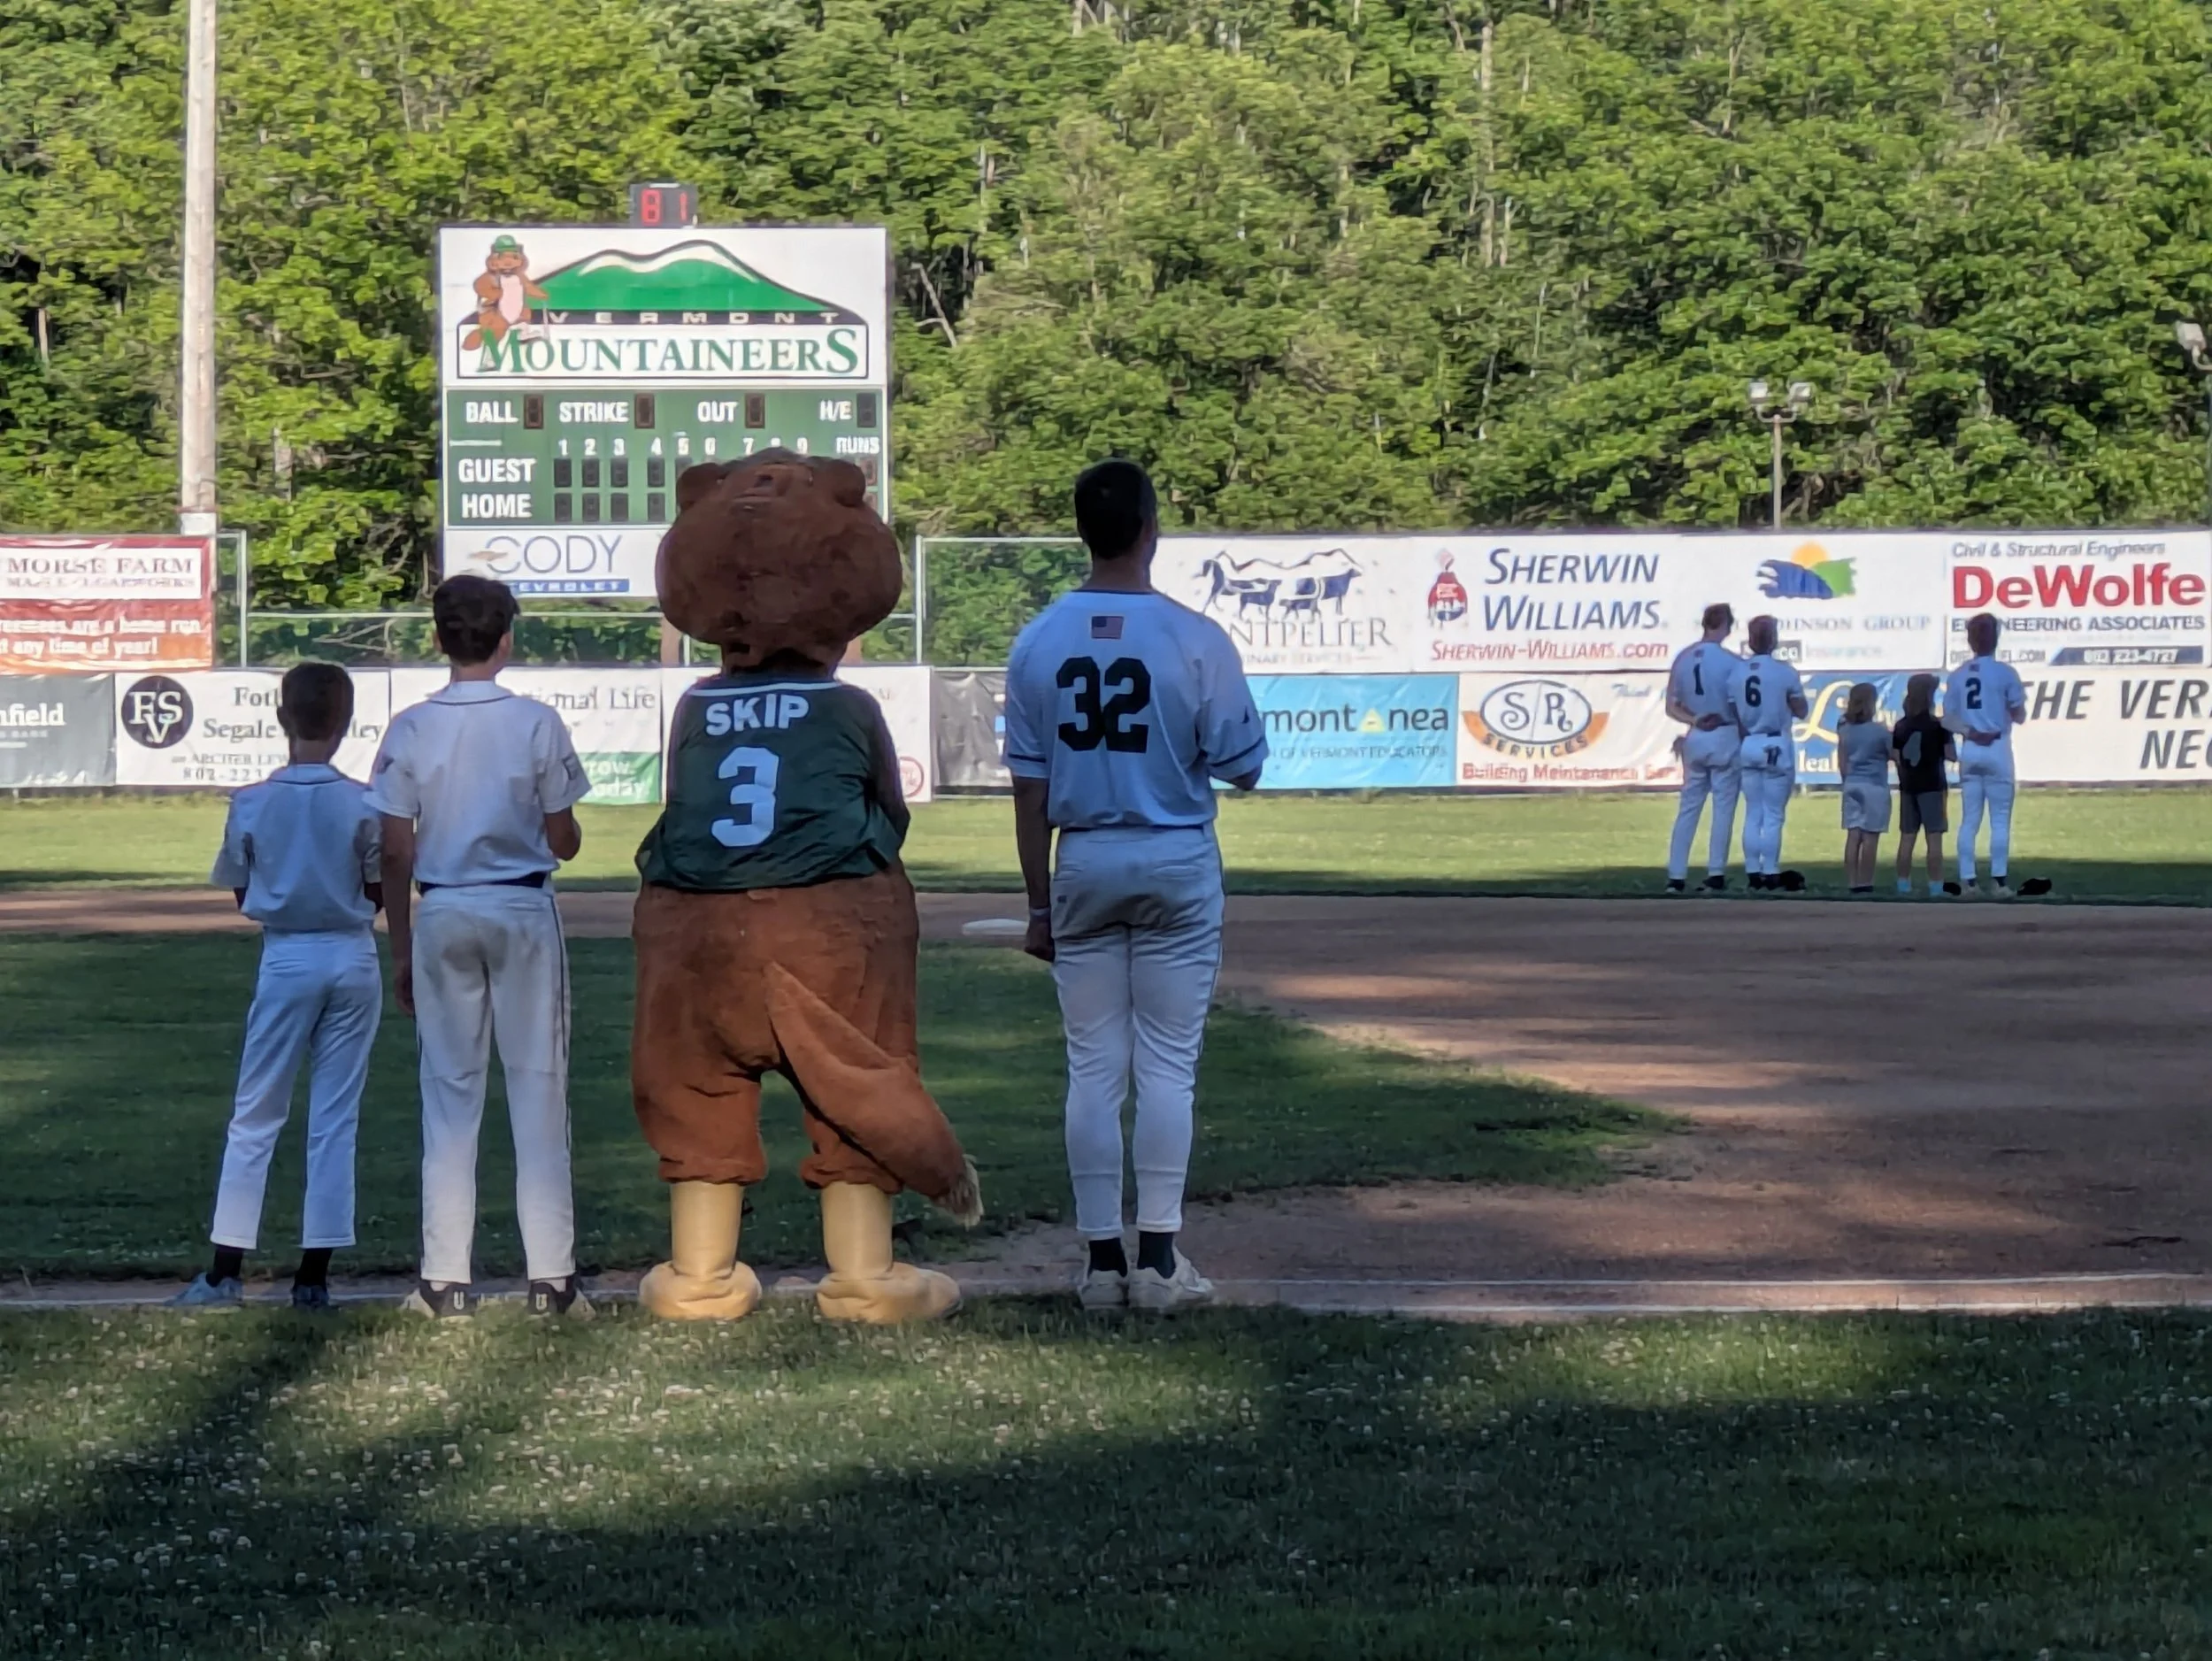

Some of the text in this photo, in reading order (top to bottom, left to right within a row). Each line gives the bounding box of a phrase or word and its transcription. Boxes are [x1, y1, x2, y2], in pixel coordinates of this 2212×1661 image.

[550, 312, 839, 325] VERMONT
[478, 328, 858, 374] MOUNTAINEERS
[465, 401, 518, 423] BALL
[559, 402, 629, 423] STRIKE
[697, 401, 738, 422] OUT
[819, 400, 852, 421] H/E
[558, 439, 568, 456] 1
[585, 439, 596, 456] 2
[650, 437, 662, 456] 4
[836, 436, 879, 455] RUNS
[458, 458, 536, 482] GUEST
[461, 493, 533, 519] HOME
[486, 534, 623, 574] CODY
[1991, 543, 2001, 556] &
[2007, 542, 2083, 558] Structural
[2085, 542, 2165, 561] Engineers
[7, 558, 192, 573] MORSE FARM
[511, 580, 621, 593] EVROLET
[1953, 563, 2206, 609] DeWolfe
[1227, 619, 1395, 648] NTPELIER
[1952, 615, 2205, 632] ENEERING ASSOCIATES
[1694, 663, 1704, 696] 1
[1745, 675, 1763, 707] 6
[610, 685, 656, 709] Life
[1056, 657, 1150, 753] 32
[1965, 677, 1982, 710] 2
[2121, 680, 2212, 719] VER
[705, 693, 809, 736] SKIP
[1263, 704, 1356, 732] mont
[203, 719, 277, 743] Segale
[1483, 733, 1590, 760] SERVICES
[2139, 729, 2212, 770] NE
[711, 746, 779, 847] 3
